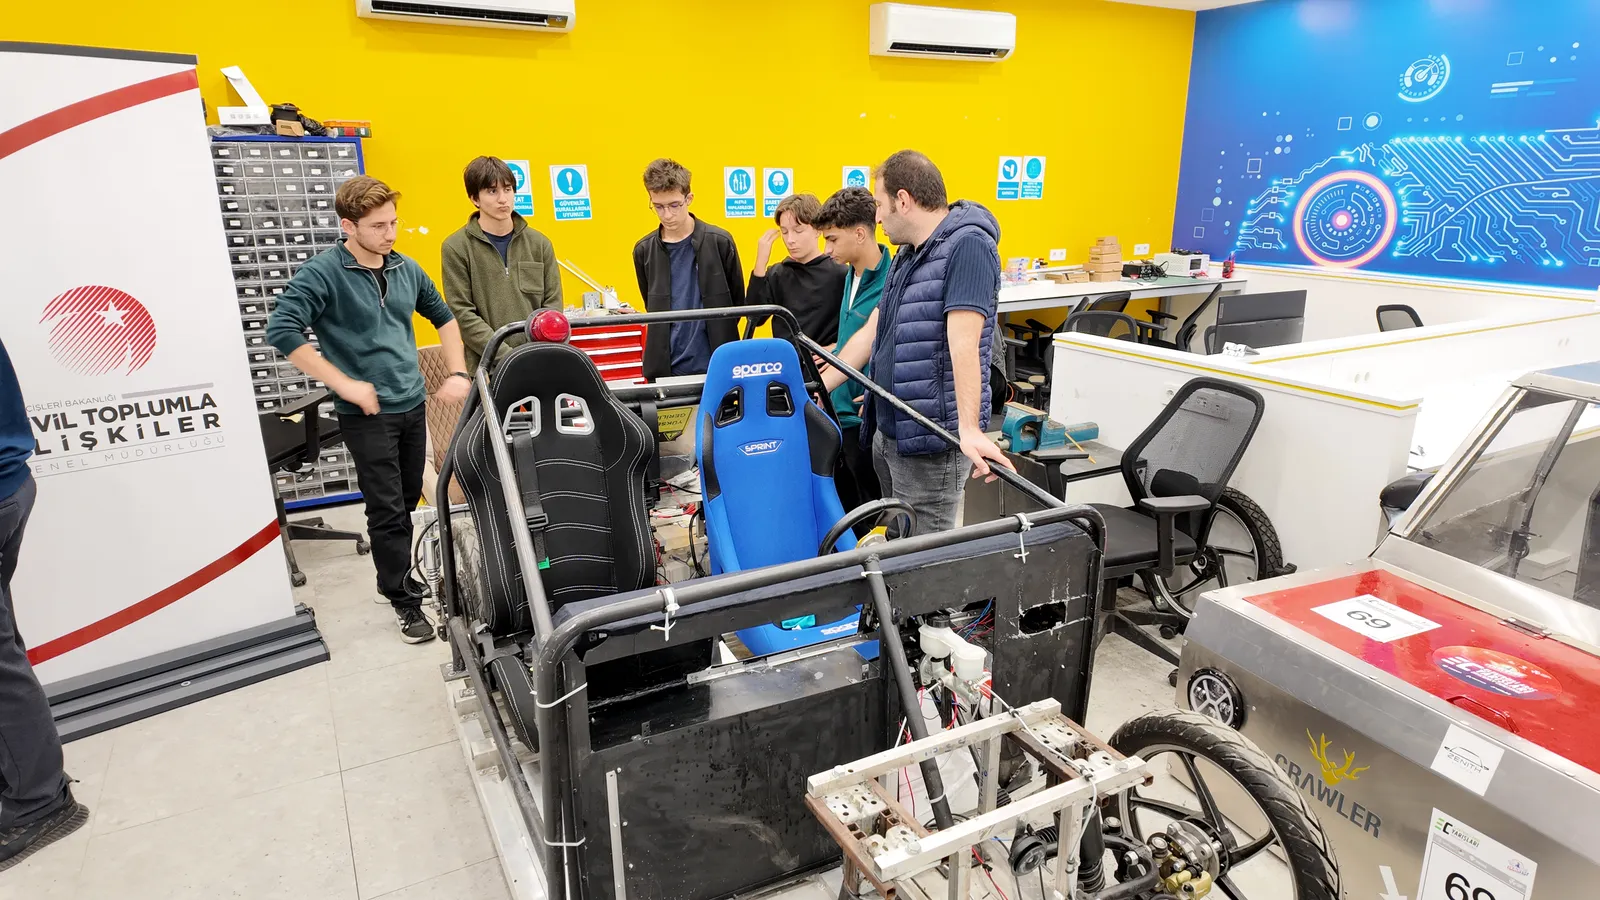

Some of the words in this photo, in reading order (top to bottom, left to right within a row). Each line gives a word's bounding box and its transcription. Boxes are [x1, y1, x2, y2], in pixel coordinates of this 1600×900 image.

[732, 362, 783, 378] sparco
[65, 394, 117, 408] BAKANLIĞI
[81, 393, 218, 426] TOPLUMLA
[34, 413, 221, 456] LİŞKİLER
[35, 457, 89, 474] ENEL
[104, 435, 225, 462] MÜDÜRLÜĞÜ
[744, 441, 777, 453] SPRINT
[1346, 610, 1391, 629] 69
[1447, 752, 1482, 773] ZENITH
[1275, 753, 1382, 839] CRAWLER
